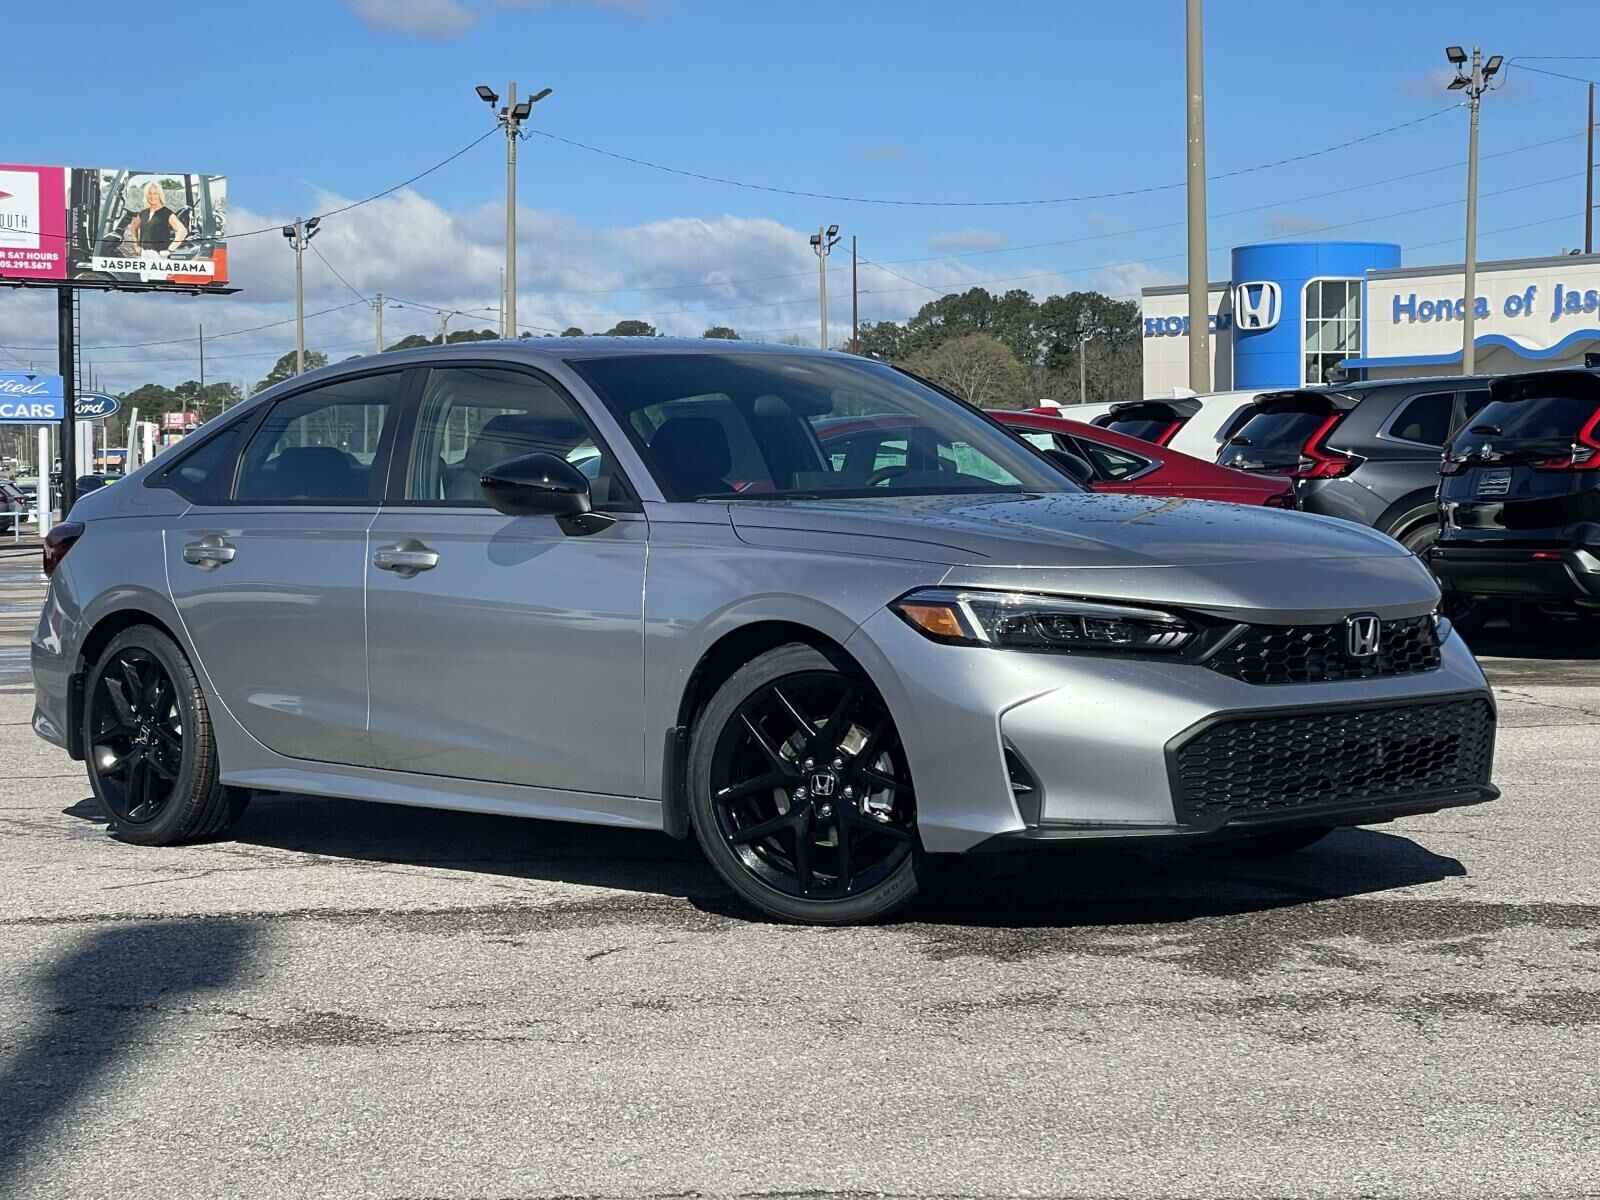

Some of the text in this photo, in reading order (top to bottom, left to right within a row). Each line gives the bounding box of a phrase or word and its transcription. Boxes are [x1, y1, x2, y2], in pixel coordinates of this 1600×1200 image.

[7, 251, 25, 259] SAT
[26, 252, 59, 260] HOURS
[0, 261, 53, 270] 05.295.5675
[101, 260, 207, 273] JASPER ALABAMA
[1504, 285, 1537, 317] of
[0, 404, 55, 418] CARS
